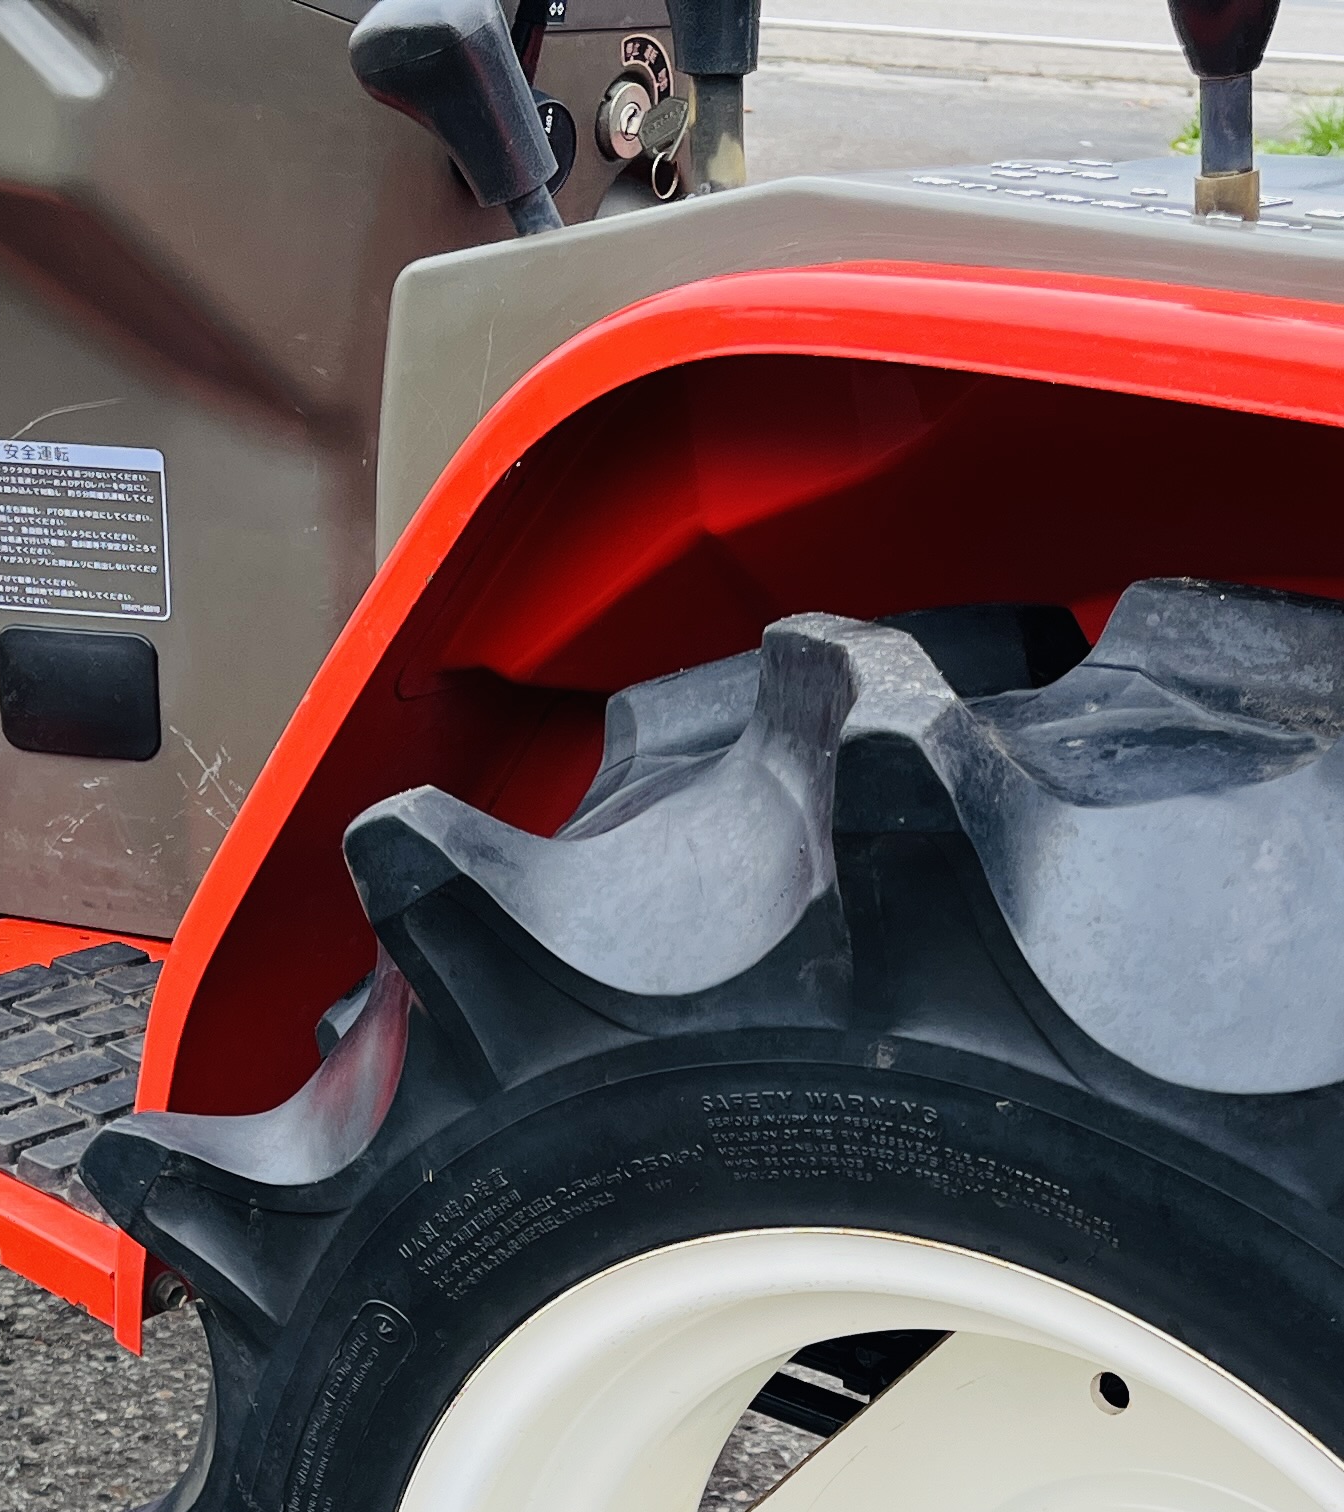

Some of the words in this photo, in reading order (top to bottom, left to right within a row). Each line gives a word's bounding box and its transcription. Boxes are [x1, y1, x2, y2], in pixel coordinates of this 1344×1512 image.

[3, 444, 70, 462] 安全運転
[702, 1091, 793, 1111] SAFETY
[805, 1091, 938, 1123] WARNING
[707, 1115, 760, 1129] SERIOUS
[712, 1130, 778, 1143] EXPLOSION
